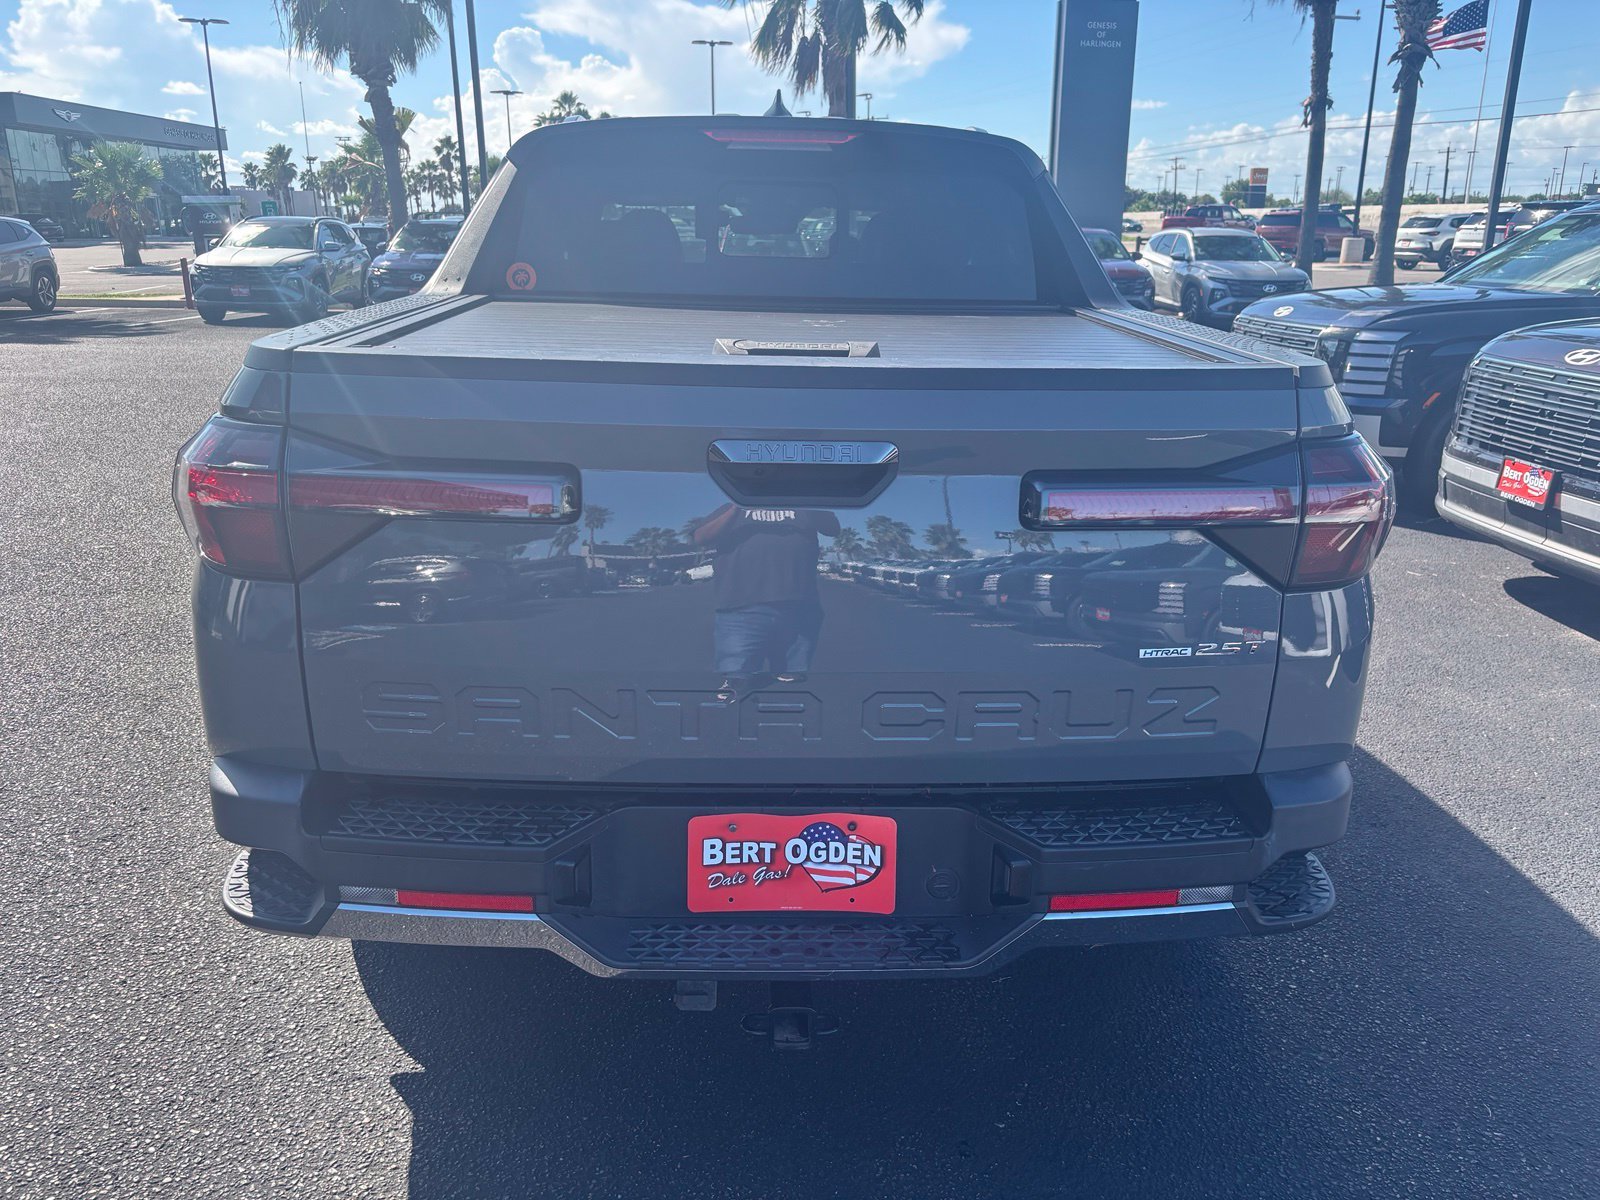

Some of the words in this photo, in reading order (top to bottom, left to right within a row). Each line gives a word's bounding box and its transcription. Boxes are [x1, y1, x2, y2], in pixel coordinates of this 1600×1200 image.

[1087, 21, 1117, 29] GENESIS
[1080, 39, 1121, 47] HARLINGEN
[757, 342, 845, 350] HYUNDAI
[746, 443, 862, 463] HYUNDAI
[1503, 465, 1523, 481] BERT
[1523, 471, 1549, 490] OGDEN
[1500, 491, 1515, 500] BERT
[1514, 496, 1536, 507] OGDEN
[1143, 648, 1188, 657] HTRAC
[362, 681, 823, 742] SANTA
[861, 685, 1221, 741] CRUZ
[702, 838, 776, 866] BERT
[784, 838, 881, 867] OGDEN
[707, 872, 746, 889] Dale
[752, 864, 792, 886] Gas!
